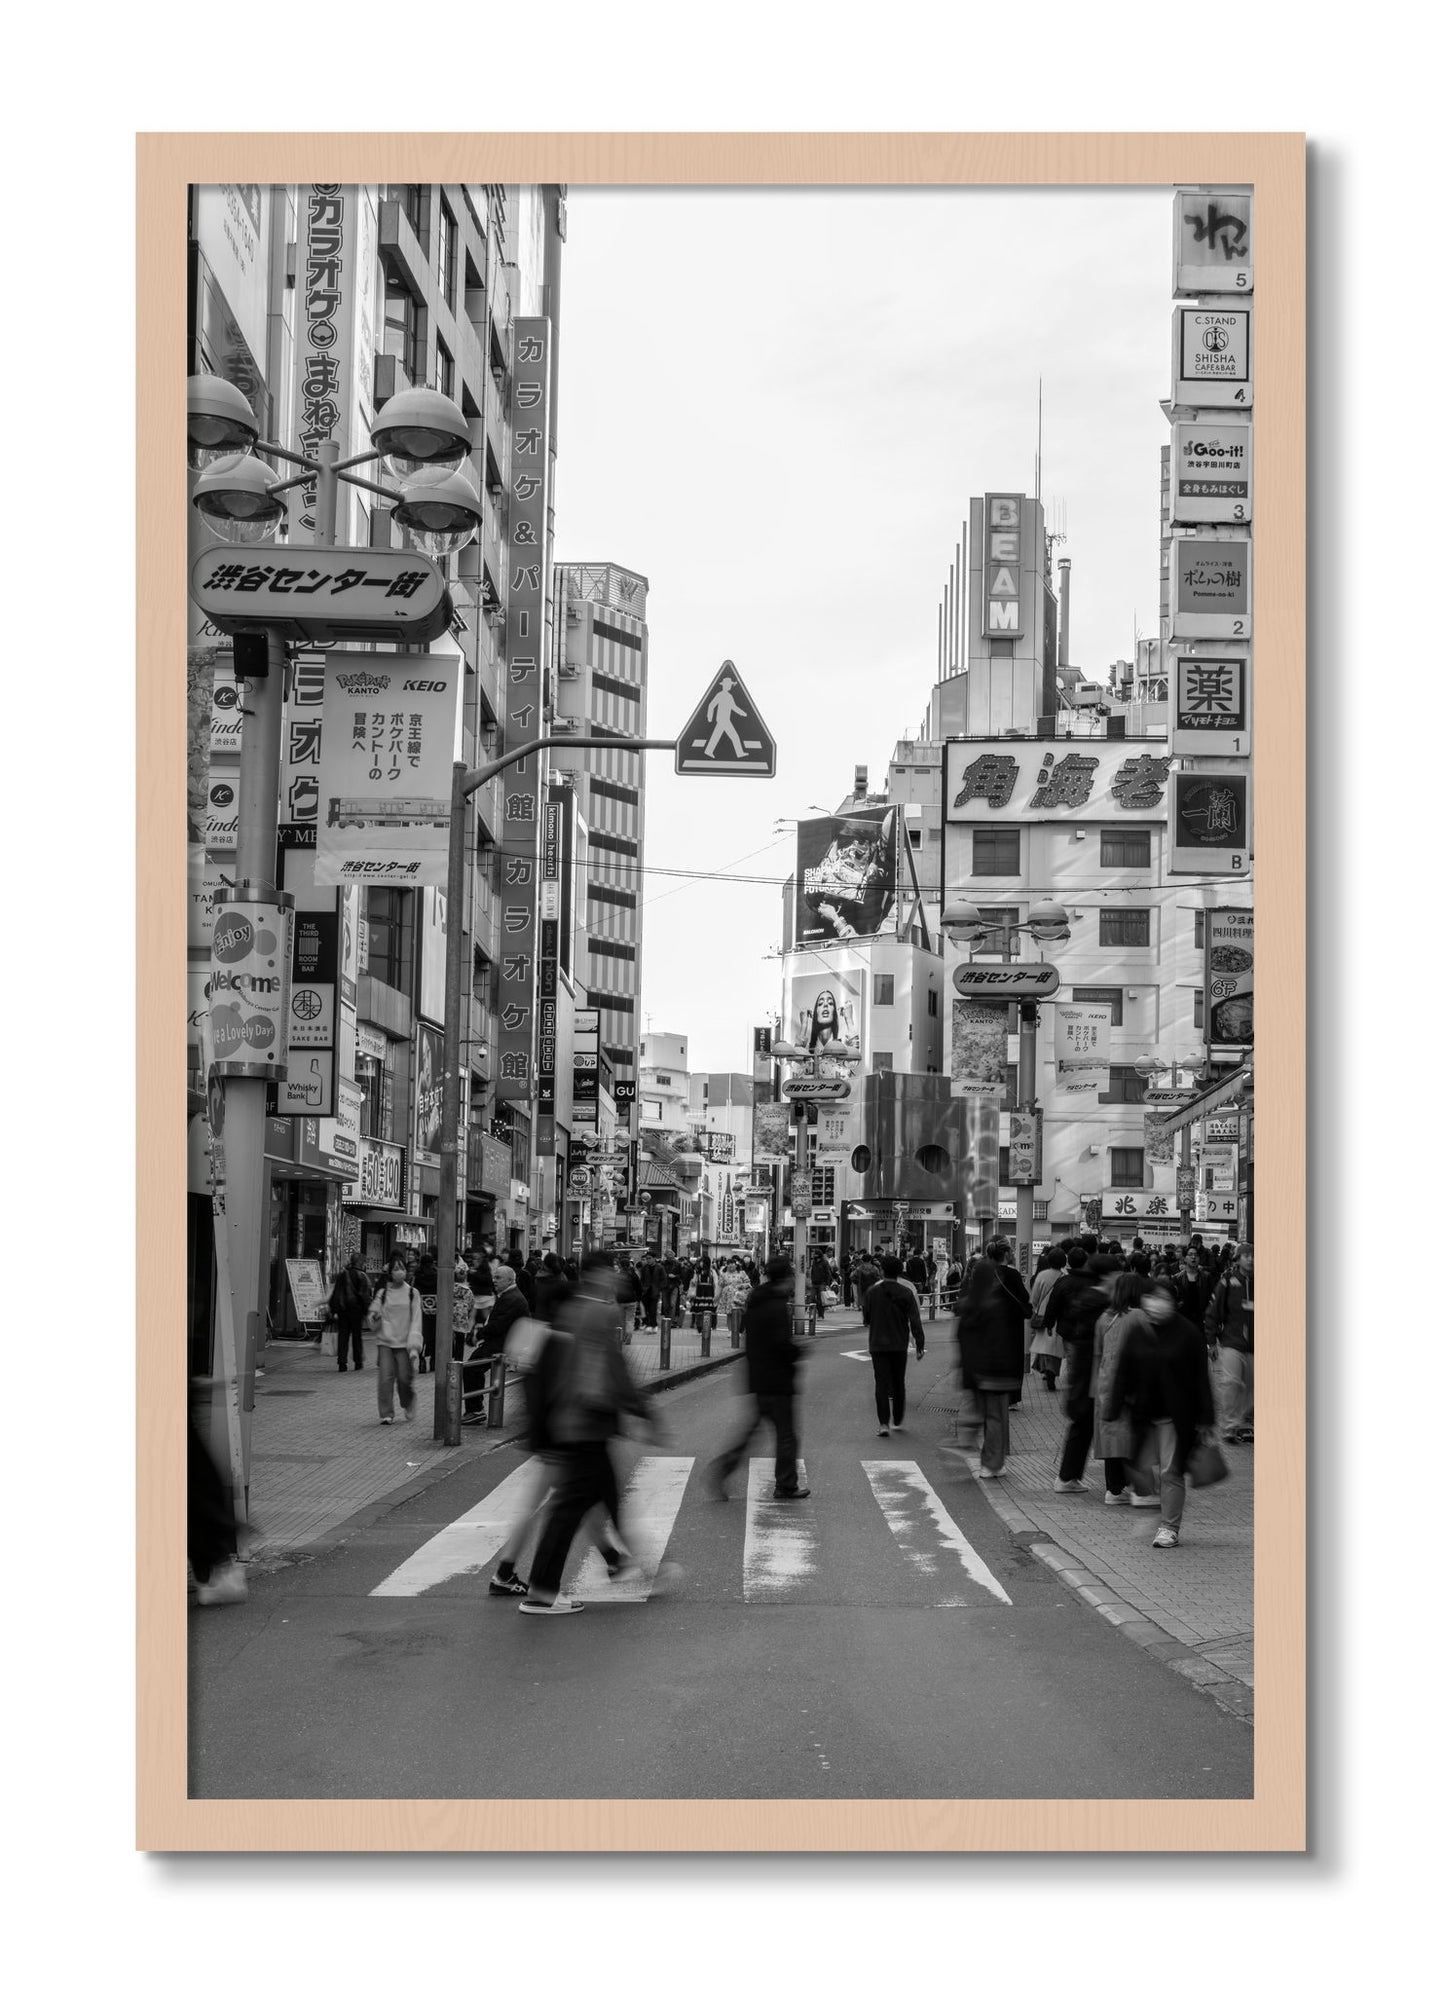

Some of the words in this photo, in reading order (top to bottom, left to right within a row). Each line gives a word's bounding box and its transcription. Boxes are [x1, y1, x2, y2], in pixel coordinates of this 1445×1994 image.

[306, 196, 344, 321] カラオケ
[1236, 273, 1247, 287] 5
[1195, 316, 1236, 325] C.STAND
[1195, 353, 1236, 363] SHISHA
[1194, 443, 1243, 457] Goo-it!
[1183, 484, 1244, 494] 全身もみほぐし
[1234, 505, 1244, 519] 3
[988, 499, 1019, 631] BEAM
[203, 565, 430, 598] 渋谷センター街
[1233, 620, 1244, 634] 2
[403, 680, 447, 692] KEIO
[1187, 665, 1233, 711] 薬
[352, 712, 366, 752] 冒険へ
[369, 712, 385, 780] カントーの
[387, 712, 404, 780] ポケパーク
[407, 713, 422, 768] 京王線で
[1233, 737, 1240, 752] 1
[954, 753, 1173, 809] 角海老
[547, 807, 556, 839] kimono
[341, 861, 421, 873] 渋谷センター街
[1232, 854, 1242, 869] B
[213, 924, 251, 956] Enjoy
[211, 970, 281, 993] Welcome
[960, 971, 1053, 984] 渋谷センター街
[1211, 979, 1238, 997] 6F
[226, 1023, 254, 1041] Lovely
[255, 1024, 274, 1037] Day!
[287, 1092, 306, 1100] Bank
[288, 1083, 319, 1096] Whisky
[616, 1086, 635, 1097] GU
[724, 1193, 732, 1232] BEER
